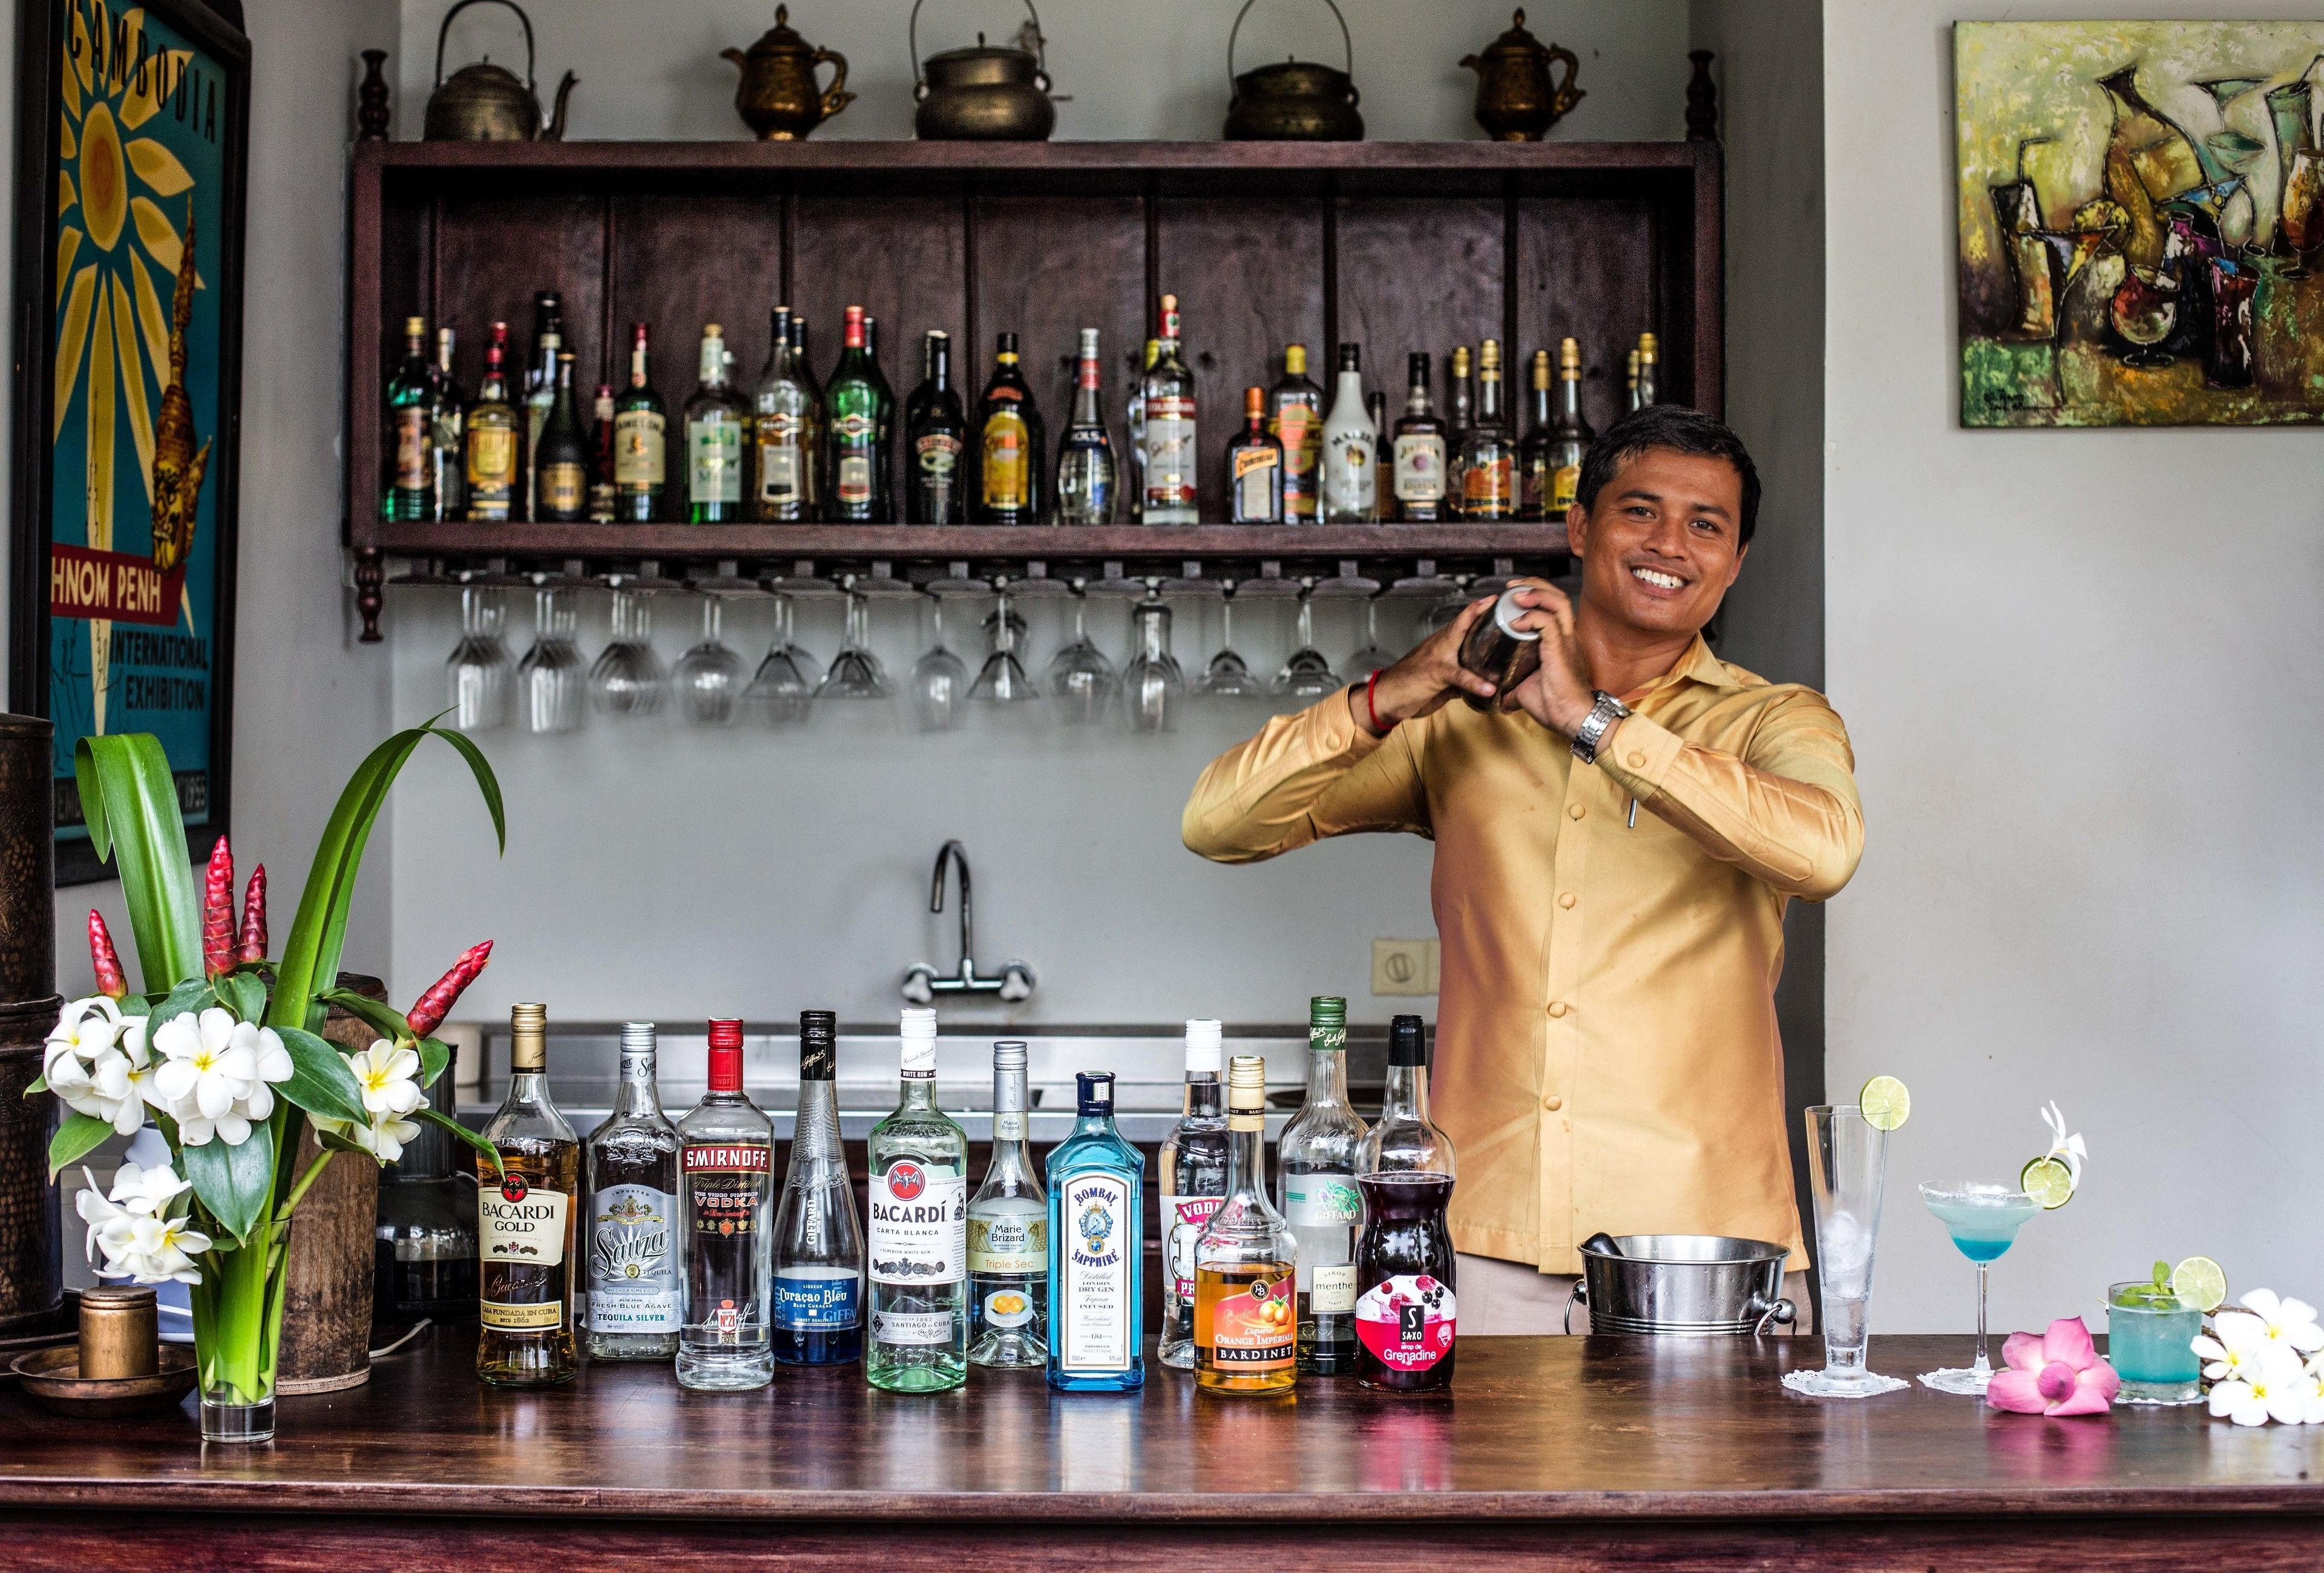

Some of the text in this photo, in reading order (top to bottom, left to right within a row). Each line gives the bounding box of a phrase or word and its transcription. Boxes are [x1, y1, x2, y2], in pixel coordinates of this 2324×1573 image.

[68, 0, 215, 143] CAMBODIA
[51, 557, 161, 614] HNOM PENH
[110, 629, 208, 672] INTERNATIONAL
[125, 674, 205, 711] EXHIBITION
[686, 1149, 767, 1167] SMIRNOFF
[693, 1177, 763, 1191] Triple Distilled
[694, 1196, 758, 1208] VODKA
[1074, 1187, 1119, 1207] BOMBAY
[482, 1201, 555, 1220] BACARDI
[873, 1199, 947, 1223] BACARDÍ
[1315, 1210, 1356, 1220] GIFFARD
[494, 1220, 535, 1232] GOLD
[806, 1198, 816, 1246] GIFFARD
[994, 1224, 1022, 1233] Marie
[877, 1227, 900, 1235] CARTA
[991, 1233, 1025, 1242] Brizard
[589, 1227, 669, 1279] Sauza
[1071, 1249, 1120, 1267] SAPPHIRE
[985, 1259, 1034, 1270] Triple Sec
[1079, 1270, 1114, 1280] Distilled
[1316, 1282, 1353, 1290] menthe
[780, 1287, 847, 1305] Curaçao Bleu
[1084, 1294, 1109, 1304] Vapour
[493, 1307, 526, 1316] FUNDADA
[1408, 1307, 1417, 1329] S
[1215, 1332, 1294, 1345] ORANGE IMPÉRIALE
[1244, 1327, 1275, 1337] Liqueur
[1402, 1331, 1422, 1341] SAXO
[1220, 1345, 1292, 1360] BARDINET
[1384, 1348, 1437, 1361] Grenadine
